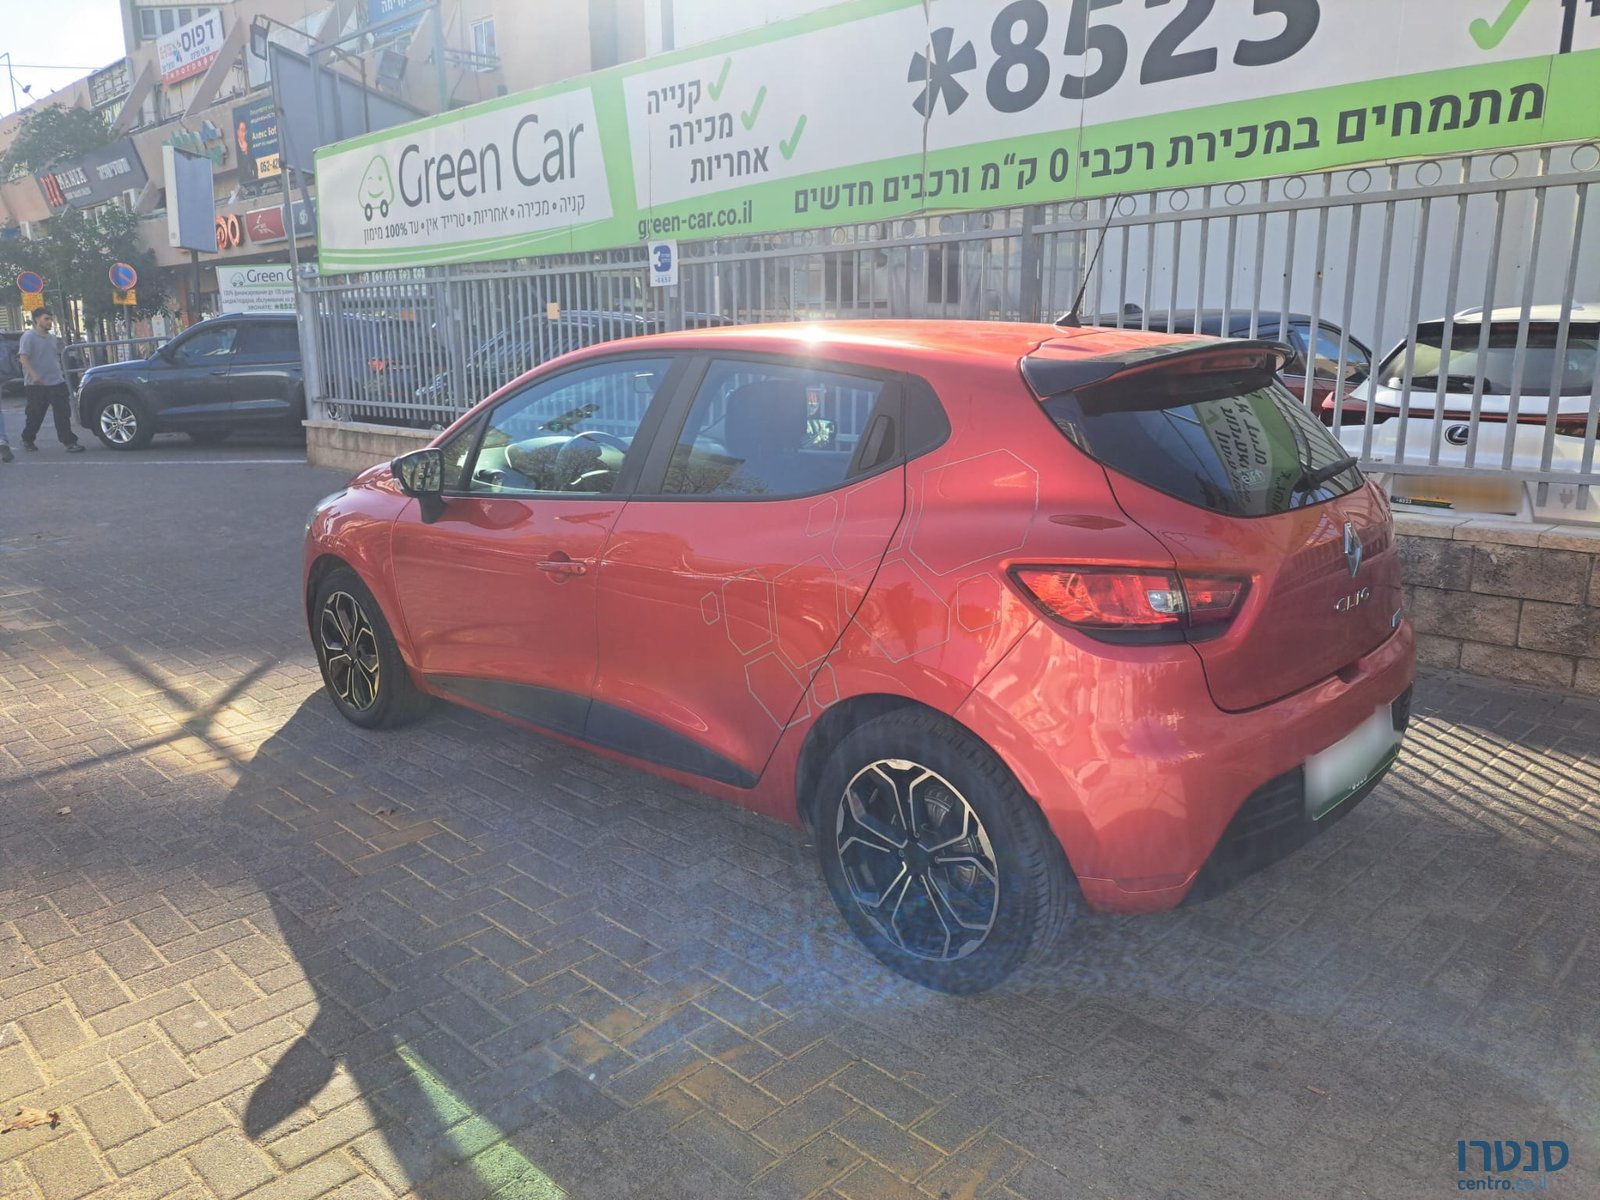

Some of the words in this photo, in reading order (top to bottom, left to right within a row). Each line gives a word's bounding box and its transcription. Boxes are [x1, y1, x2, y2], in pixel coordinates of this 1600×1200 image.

[181, 19, 214, 53] דפוס
[647, 79, 701, 115] קנייה
[1336, 82, 1545, 145] מתמחים
[669, 112, 733, 149] מכירה
[1166, 117, 1320, 167] במכירת
[399, 144, 501, 207] Green
[512, 114, 584, 186] Car
[690, 146, 769, 184] אחריות
[1080, 141, 1154, 178] רכבי
[794, 180, 874, 213] חדשים
[883, 166, 970, 202] ורכבים
[440, 212, 465, 229] טרייד
[473, 205, 508, 226] אחריות
[517, 199, 549, 219] מכירה
[559, 194, 585, 215] קניה
[638, 200, 752, 239] green-car.co.il
[363, 226, 383, 245] מימון
[385, 222, 408, 238] 100%
[408, 220, 419, 235] עד
[425, 217, 438, 237] אין
[247, 269, 283, 283] Green
[1334, 586, 1370, 612] CLIO
